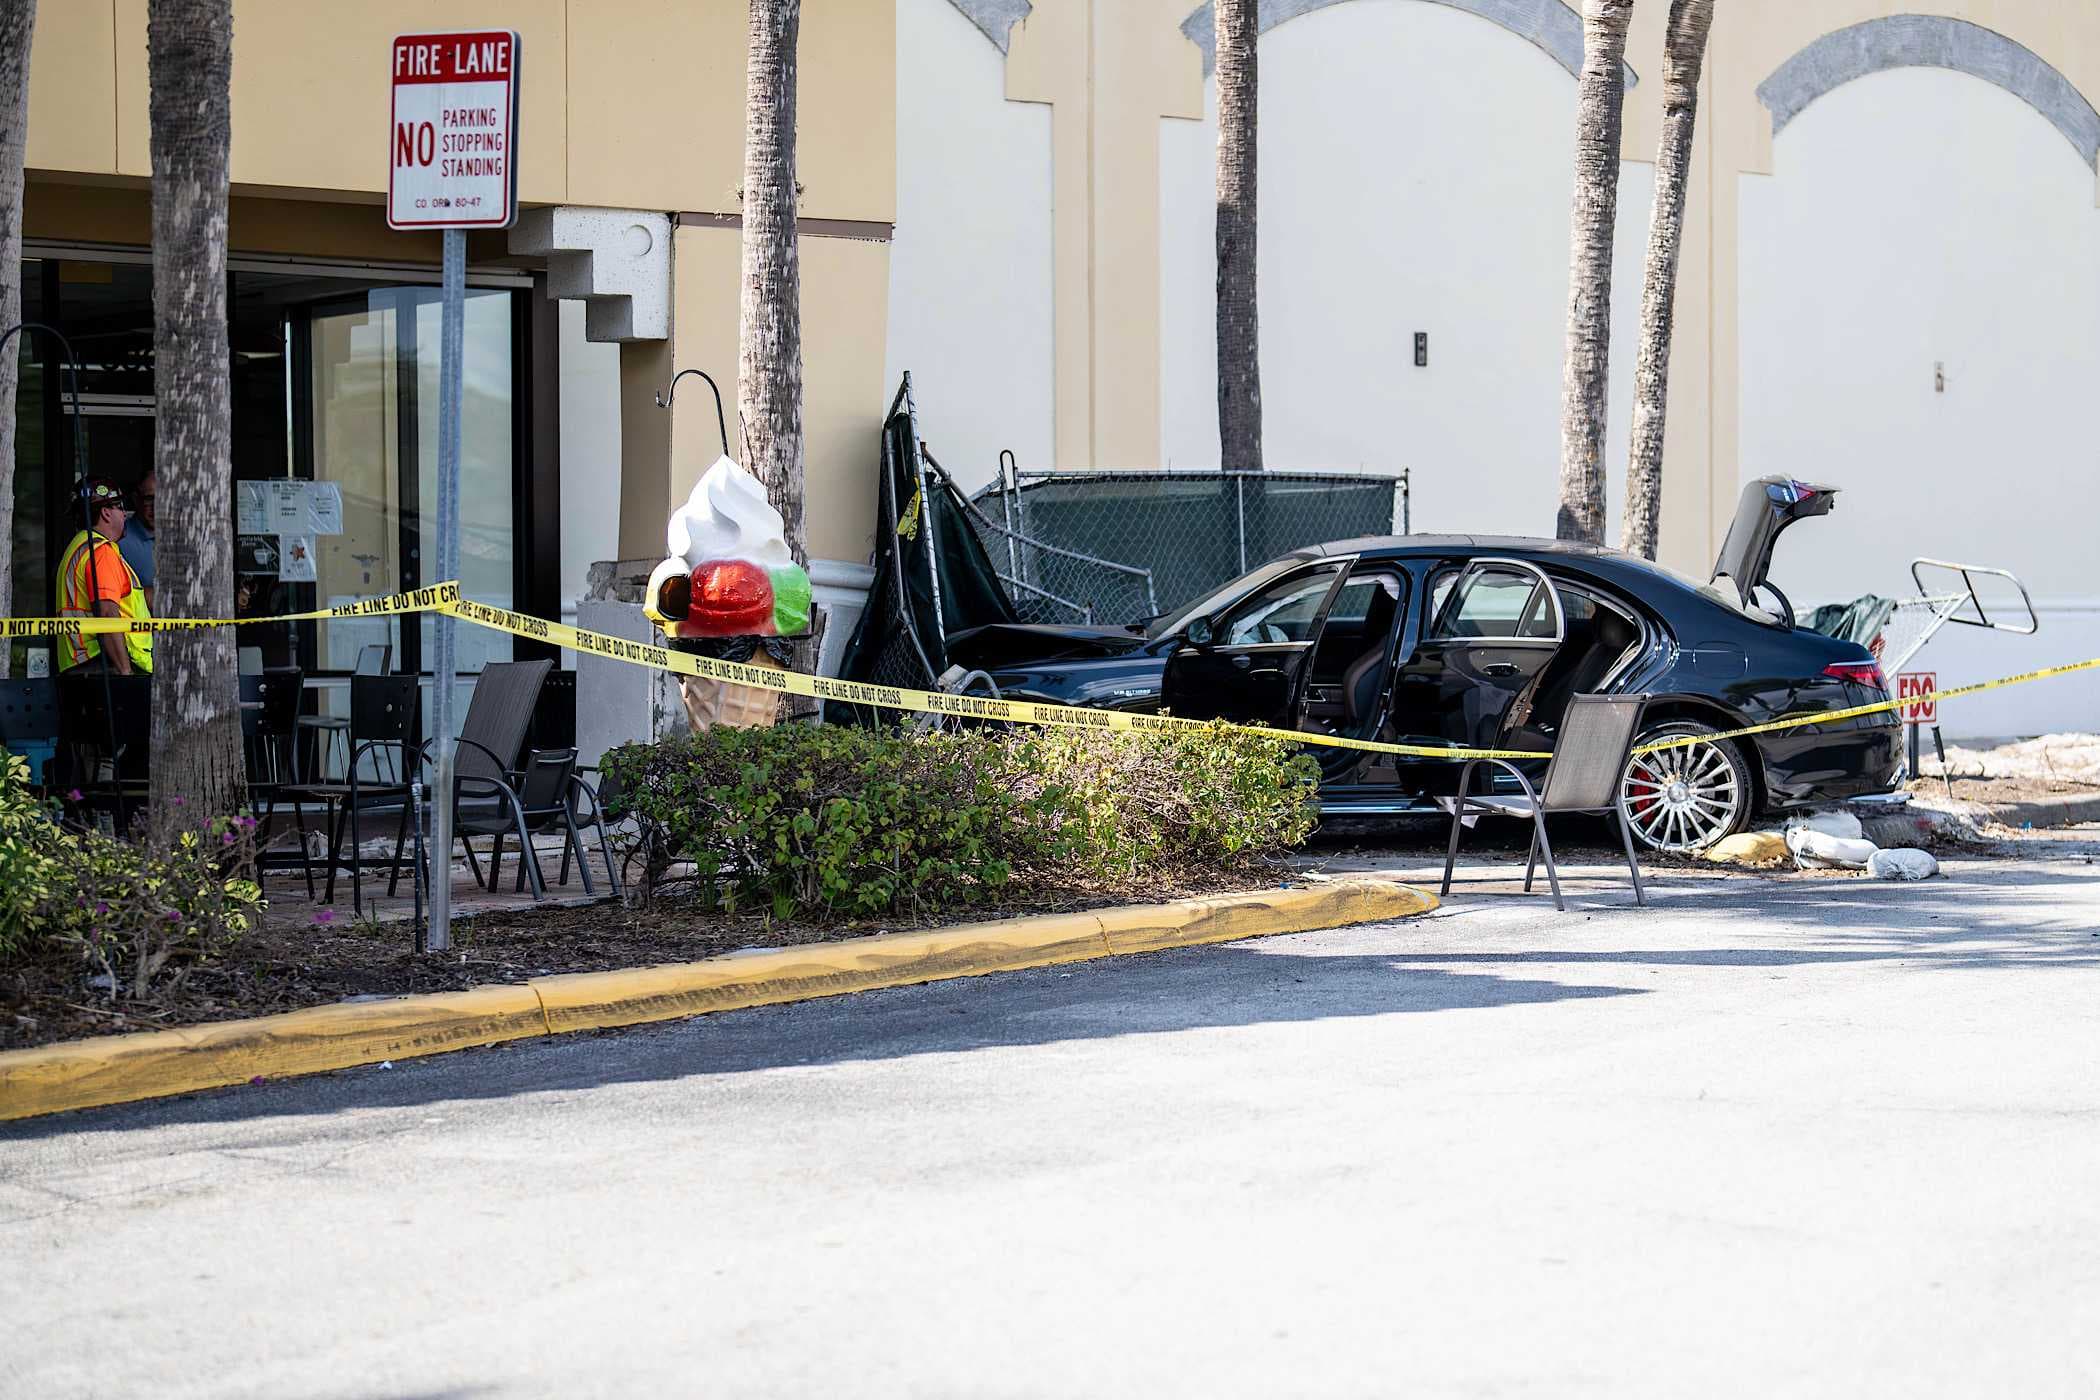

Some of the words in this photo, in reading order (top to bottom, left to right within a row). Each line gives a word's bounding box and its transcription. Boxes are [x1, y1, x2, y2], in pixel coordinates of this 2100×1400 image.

[396, 44, 442, 77] FIRE
[454, 42, 509, 74] LANE
[443, 108, 496, 128] PARKING
[397, 121, 435, 167] NO
[442, 133, 502, 153] STOPPING
[441, 158, 502, 177] STANDING
[362, 597, 390, 614] LINE
[393, 593, 409, 610] DO
[414, 588, 437, 607] NOT
[9, 620, 34, 635] NOT
[38, 620, 80, 635] CROSS
[130, 621, 158, 633] FIRE
[474, 605, 492, 622] LINE
[493, 609, 505, 626] DO
[506, 612, 521, 630] NOT
[522, 616, 549, 637] CROSS
[576, 631, 594, 650] FIRE
[594, 634, 612, 654] LINE
[613, 639, 624, 657] DO
[626, 642, 641, 660] NOT
[643, 646, 669, 666] CROSS
[696, 658, 713, 676] FIRE
[715, 662, 732, 679] LINE
[732, 665, 743, 681] DO
[745, 668, 760, 685] NOT
[762, 670, 786, 689] CROSS
[813, 679, 830, 696] FIRE
[831, 682, 848, 698] LINE
[849, 684, 859, 700] DO
[861, 686, 875, 702] NOT
[877, 688, 901, 705] CROSS
[1899, 676, 1934, 718] FDC
[927, 694, 943, 711] FIRE
[944, 697, 960, 712] LINE
[962, 698, 972, 713] DO
[973, 700, 986, 715] NOT
[987, 701, 1010, 718] CROSS
[1034, 706, 1049, 721] FIRE
[1050, 708, 1064, 723] LINE
[1064, 709, 1074, 724] DO
[1075, 710, 1088, 725] NOT
[1089, 712, 1110, 727] CROSS
[1131, 716, 1145, 729] FIRE
[1146, 718, 1160, 729] LINE
[1171, 719, 1184, 730] NOT
